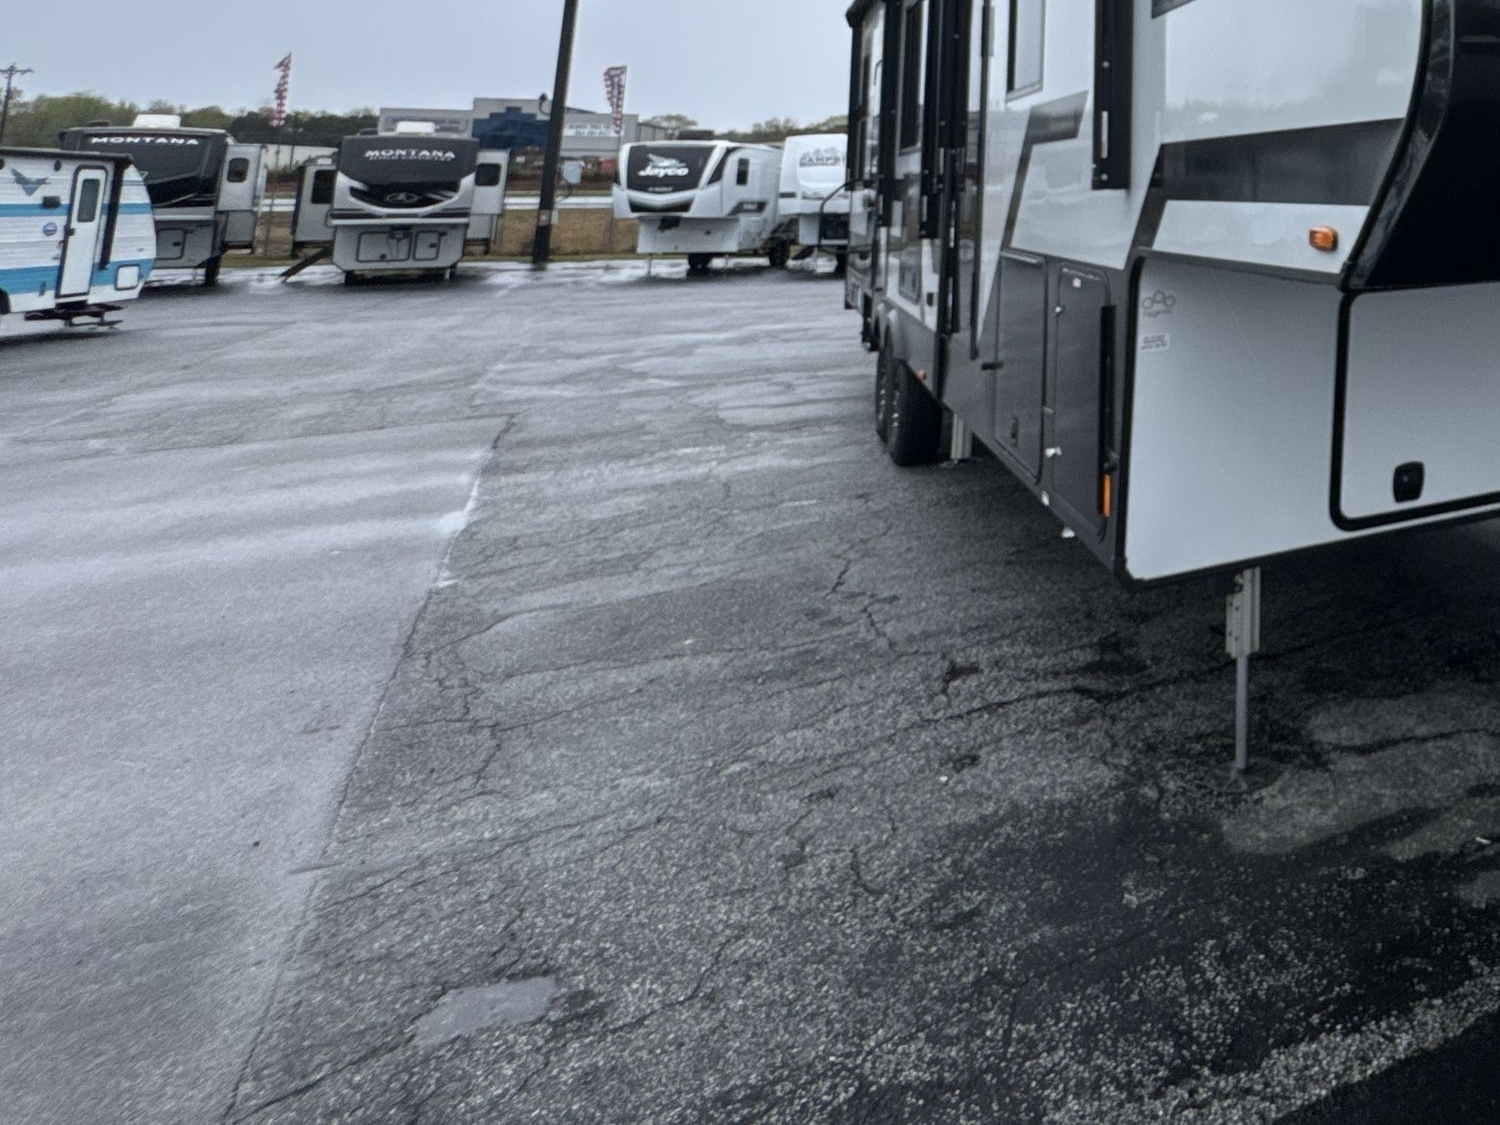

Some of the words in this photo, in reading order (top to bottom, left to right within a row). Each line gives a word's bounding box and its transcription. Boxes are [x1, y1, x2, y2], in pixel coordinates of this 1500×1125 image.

[91, 136, 199, 146] MONTANA
[364, 148, 456, 159] MONTANA
[637, 164, 689, 178] Jayco
